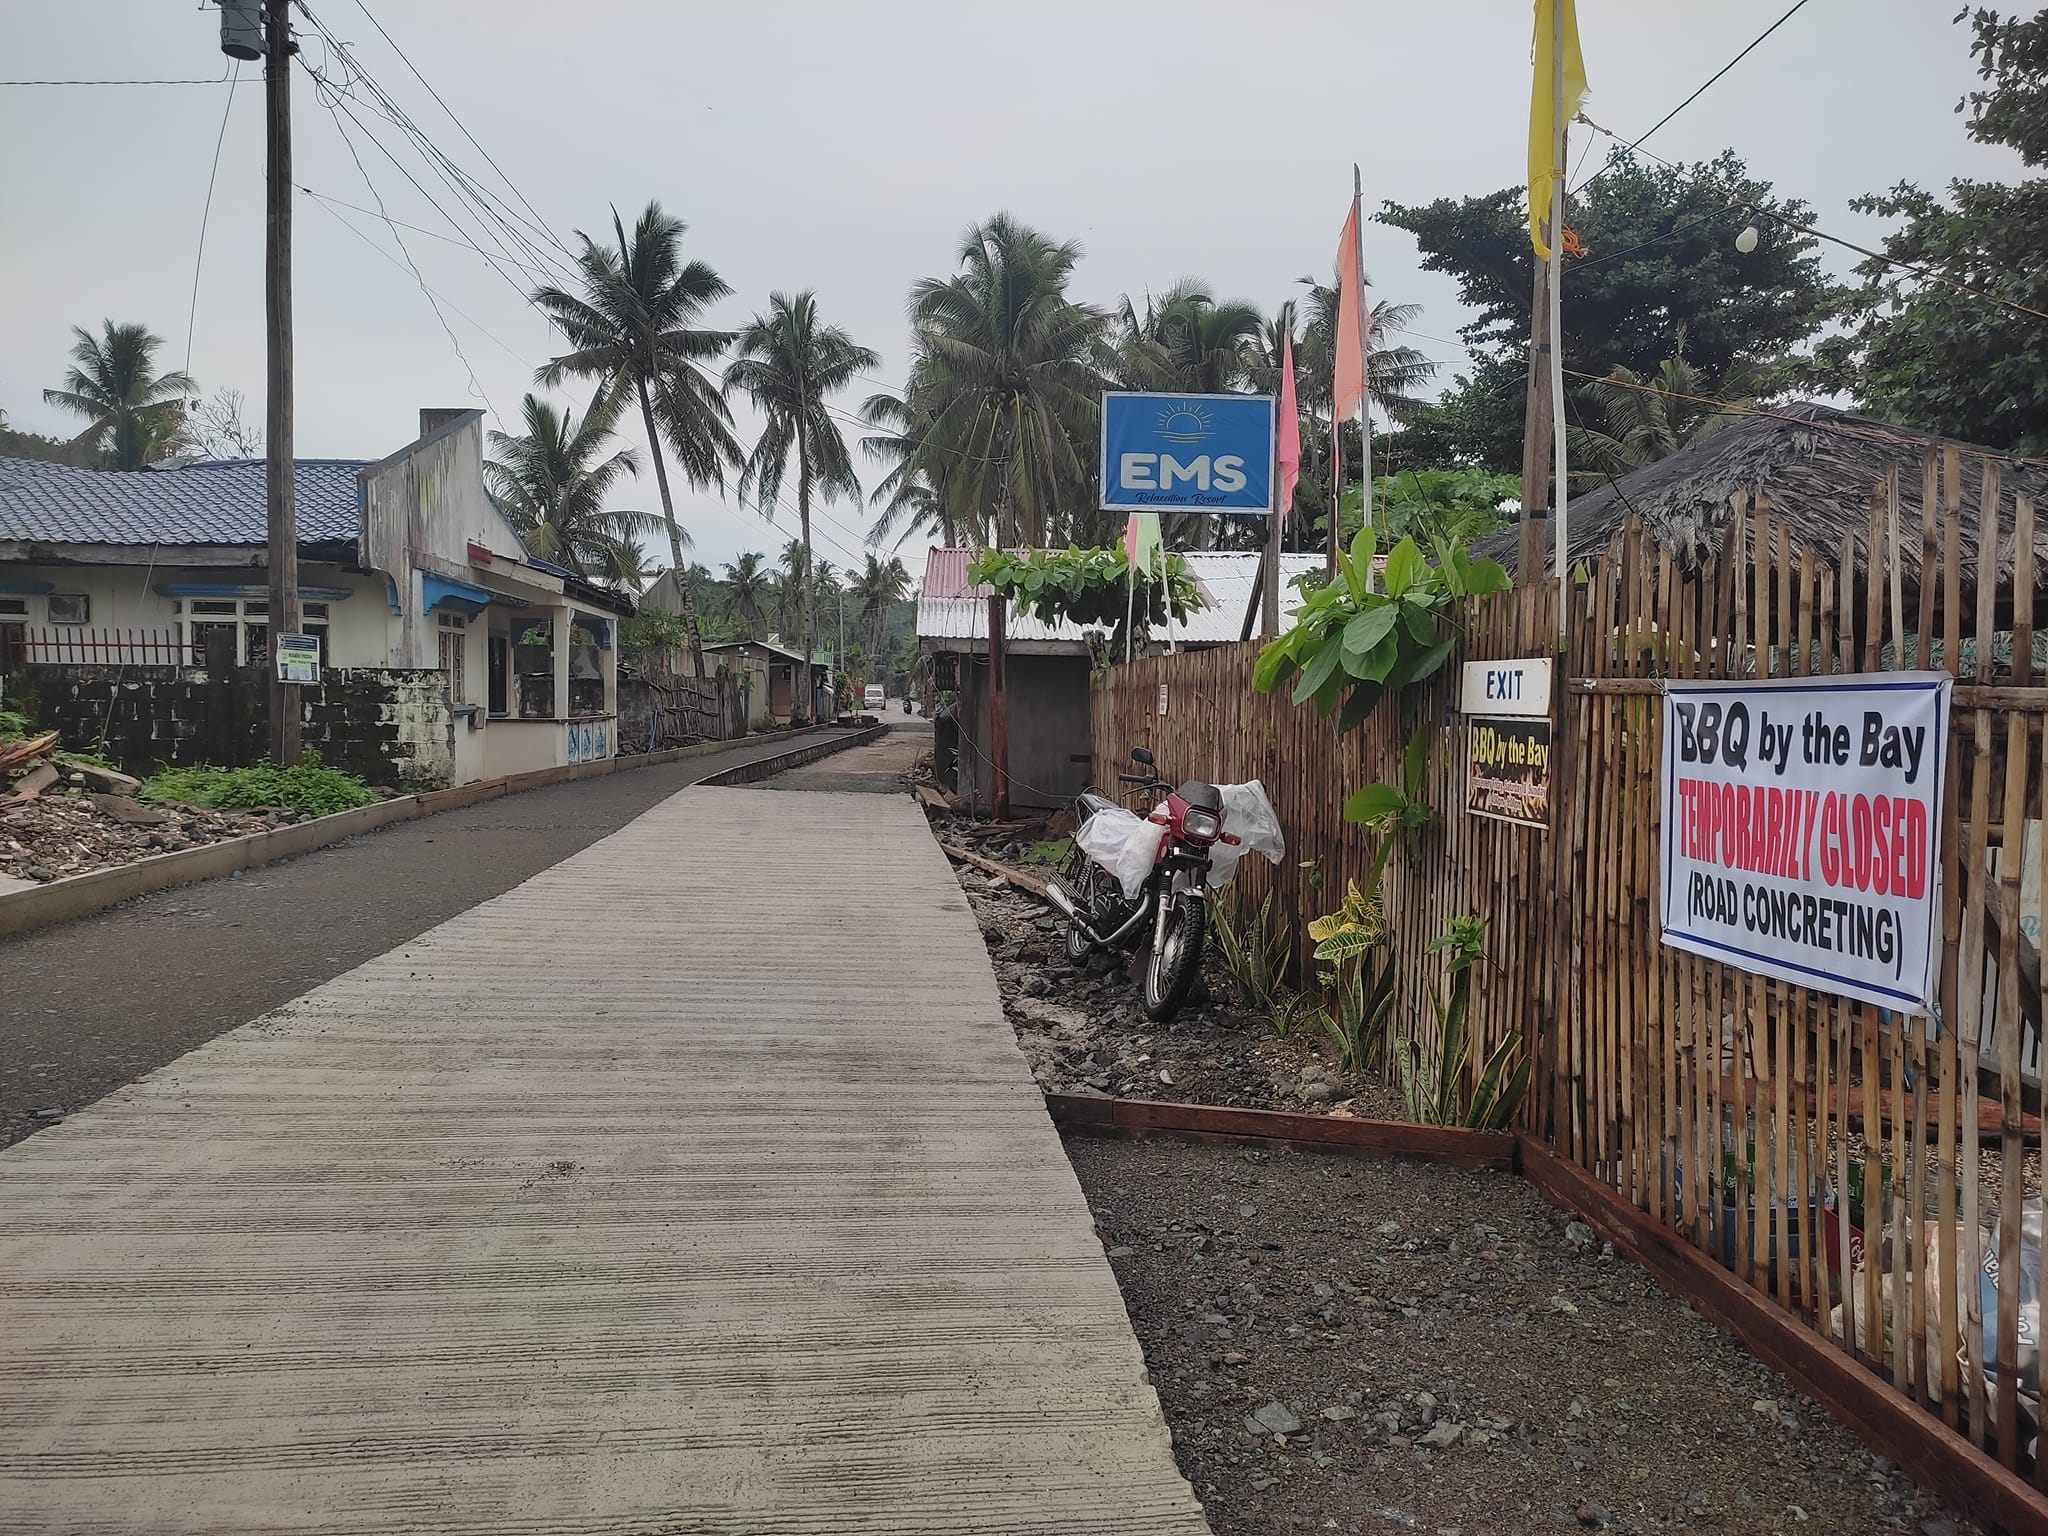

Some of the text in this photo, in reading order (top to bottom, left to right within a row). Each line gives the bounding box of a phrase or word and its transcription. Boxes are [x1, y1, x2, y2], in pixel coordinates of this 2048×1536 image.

[1121, 453, 1247, 492] EMS
[1135, 492, 1227, 505] Relaxation Resort
[1487, 670, 1523, 700] EXIT
[1472, 726, 1549, 775] BBQ by the Bay
[1677, 701, 1925, 784] BBQ by the Bay
[1679, 778, 1927, 900] TEMPORARILY CLOSED
[1687, 870, 1904, 981] (ROAD CONCRETING)
